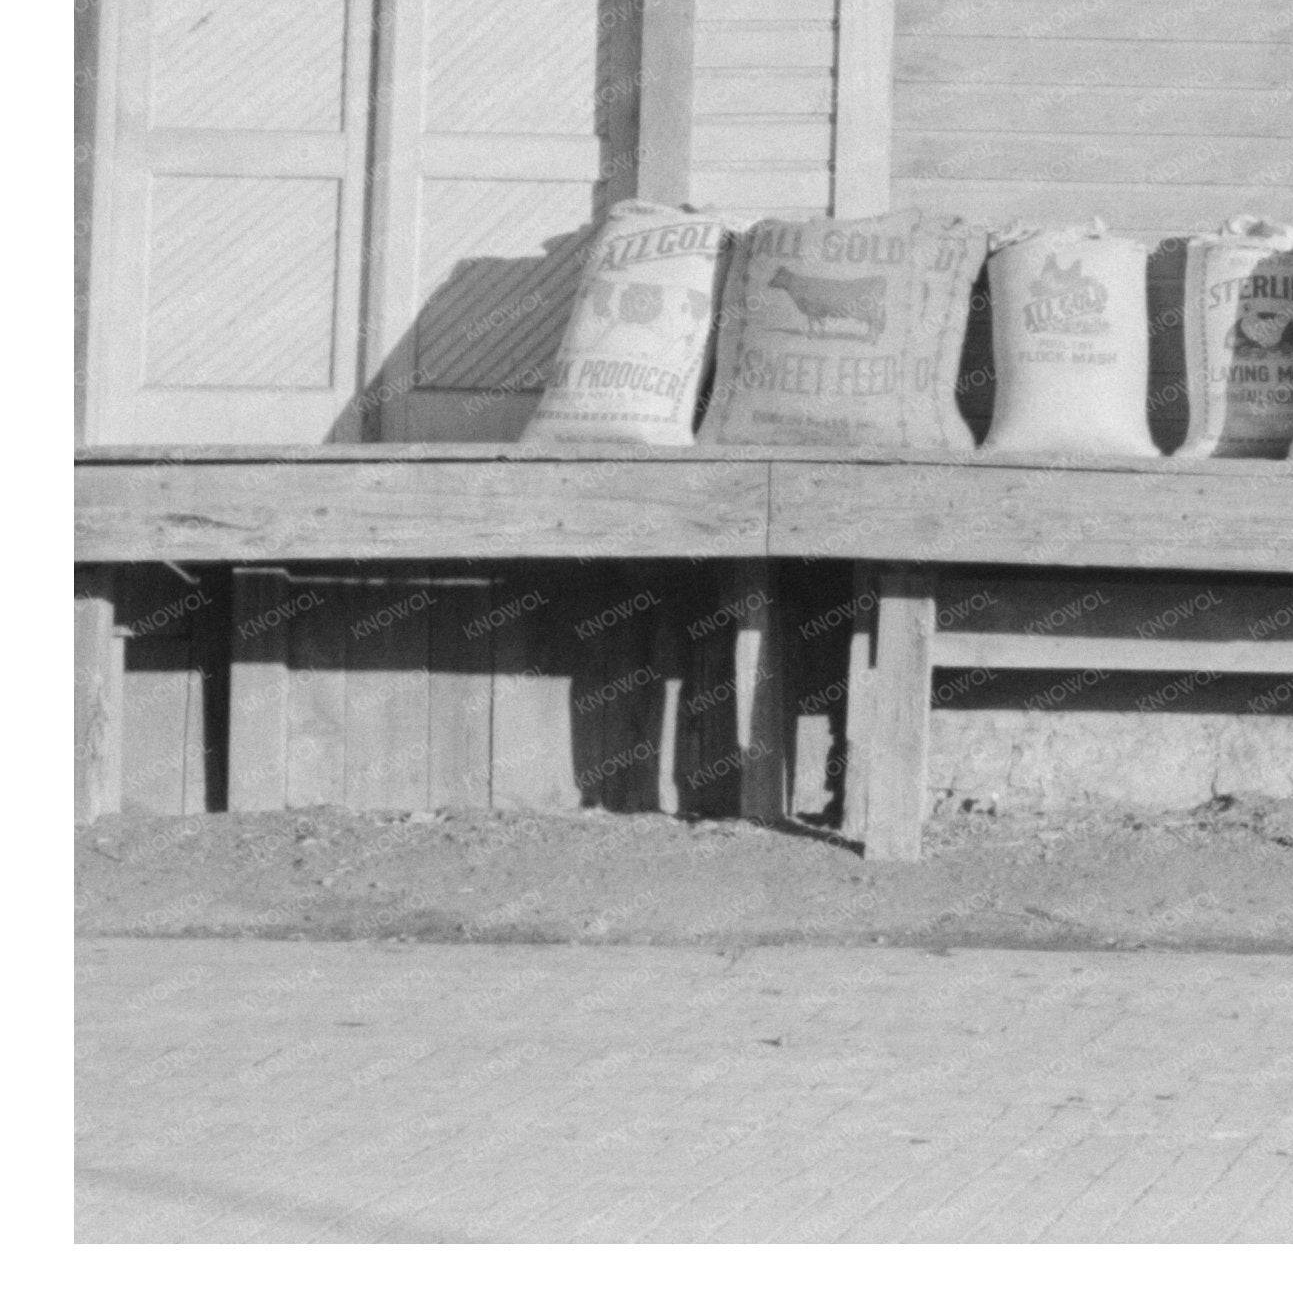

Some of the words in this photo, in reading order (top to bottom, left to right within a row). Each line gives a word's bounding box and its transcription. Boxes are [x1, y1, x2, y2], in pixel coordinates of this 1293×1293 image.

[656, 224, 714, 255] GOL
[823, 229, 905, 265] GOLD
[838, 354, 897, 397] FEED
[1017, 350, 1066, 365] FLOCK
[1071, 352, 1118, 365] MASH
[577, 358, 681, 399] PRODUCER
